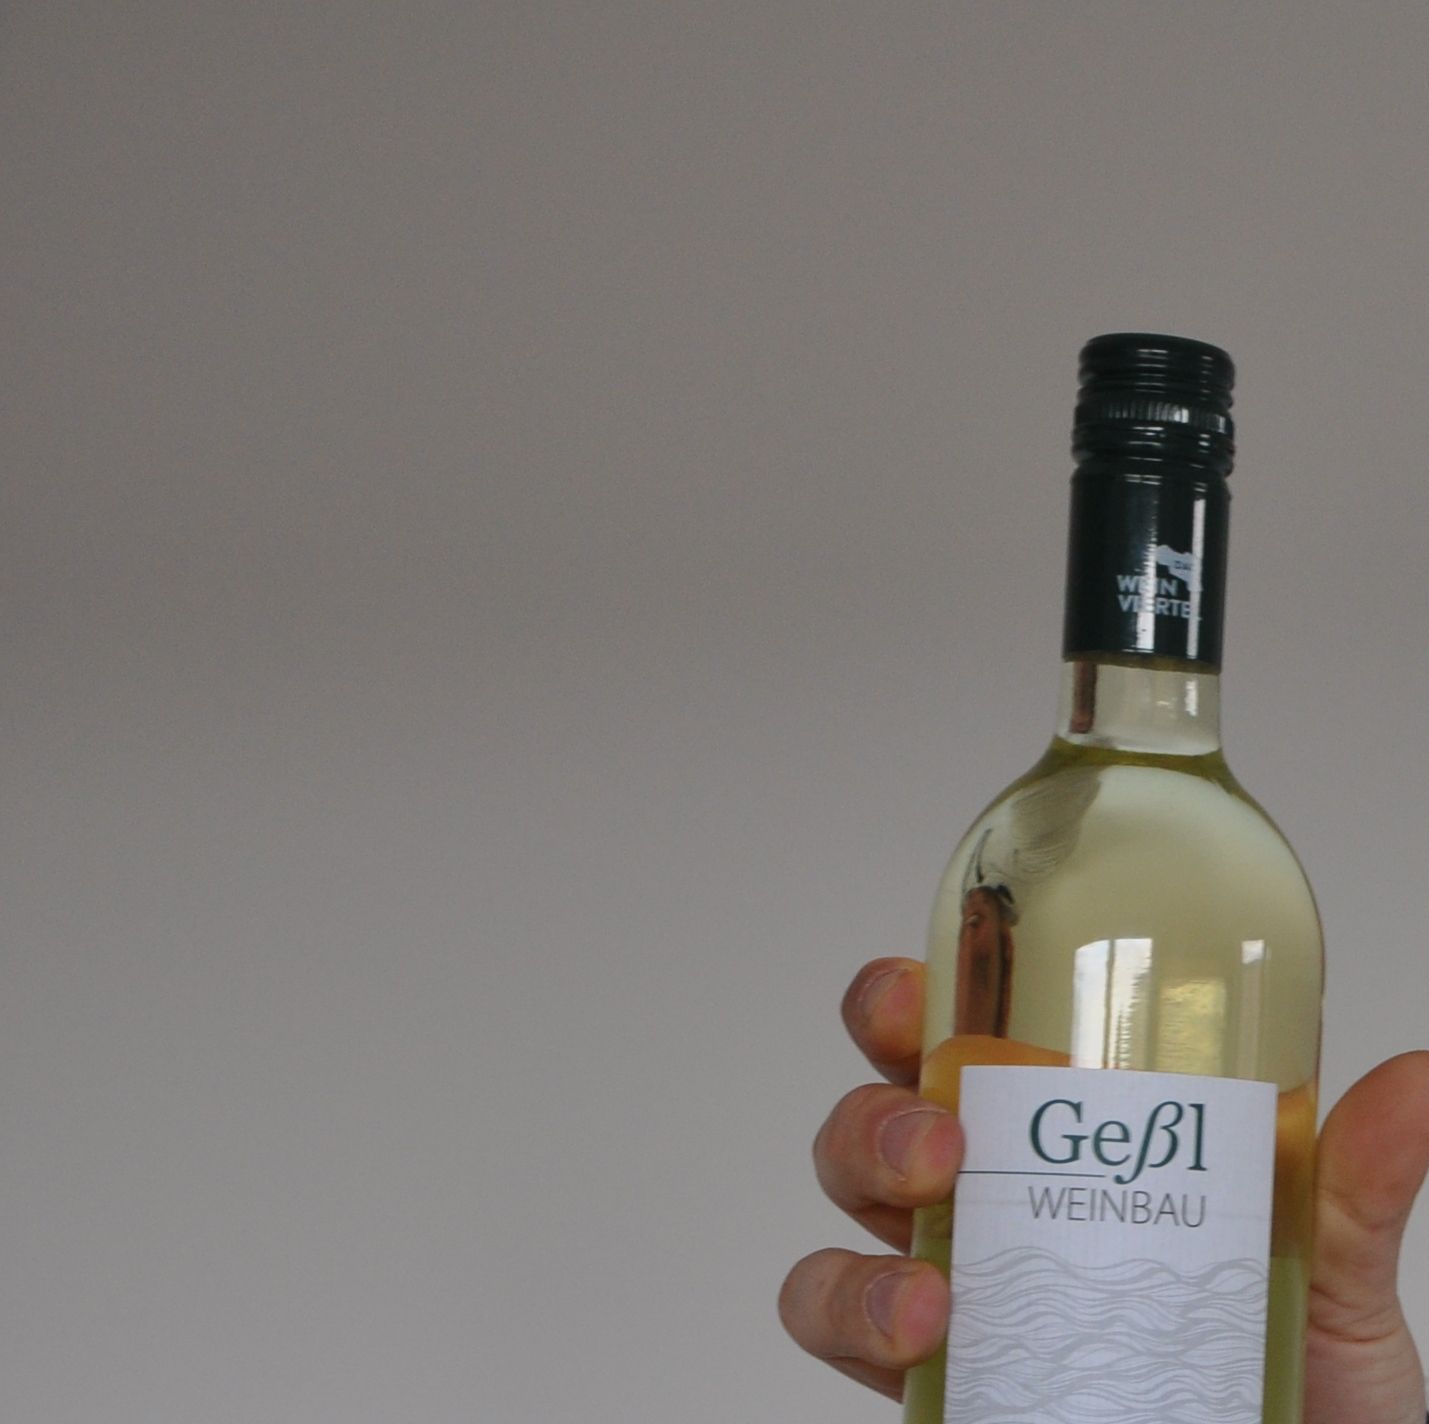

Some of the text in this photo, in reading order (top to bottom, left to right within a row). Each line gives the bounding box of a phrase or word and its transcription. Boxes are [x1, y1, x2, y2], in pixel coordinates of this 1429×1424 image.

[1117, 575, 1178, 596] WN
[1118, 594, 1202, 620] VIRTE
[1028, 1186, 1207, 1227] WEINBAU
